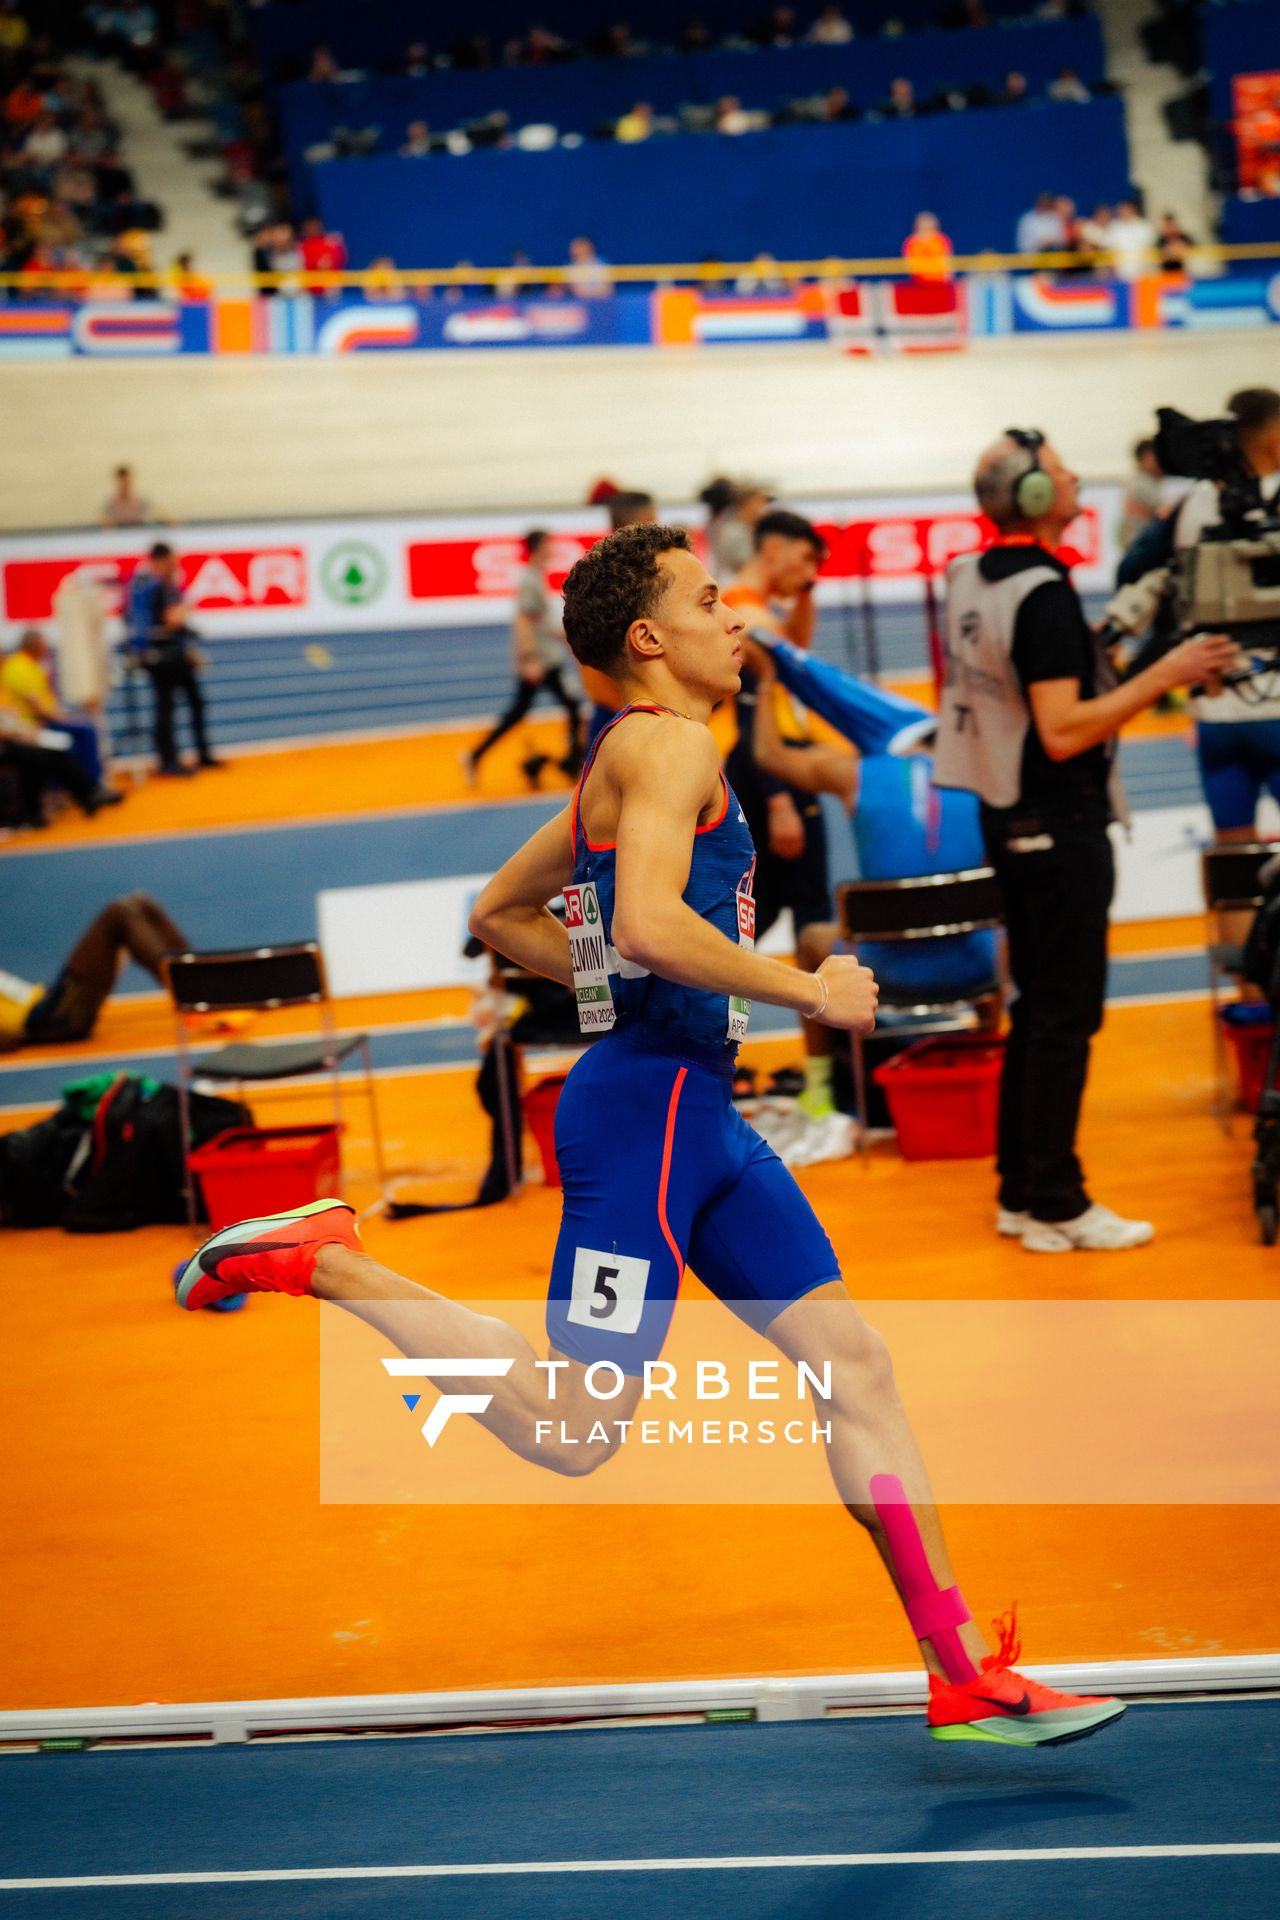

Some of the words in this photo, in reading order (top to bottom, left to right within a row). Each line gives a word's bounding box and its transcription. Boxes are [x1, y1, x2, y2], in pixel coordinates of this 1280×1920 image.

[564, 894, 582, 922] AR
[598, 1008, 615, 1023] 2025
[732, 1018, 746, 1035] APE
[590, 1265, 620, 1319] 5
